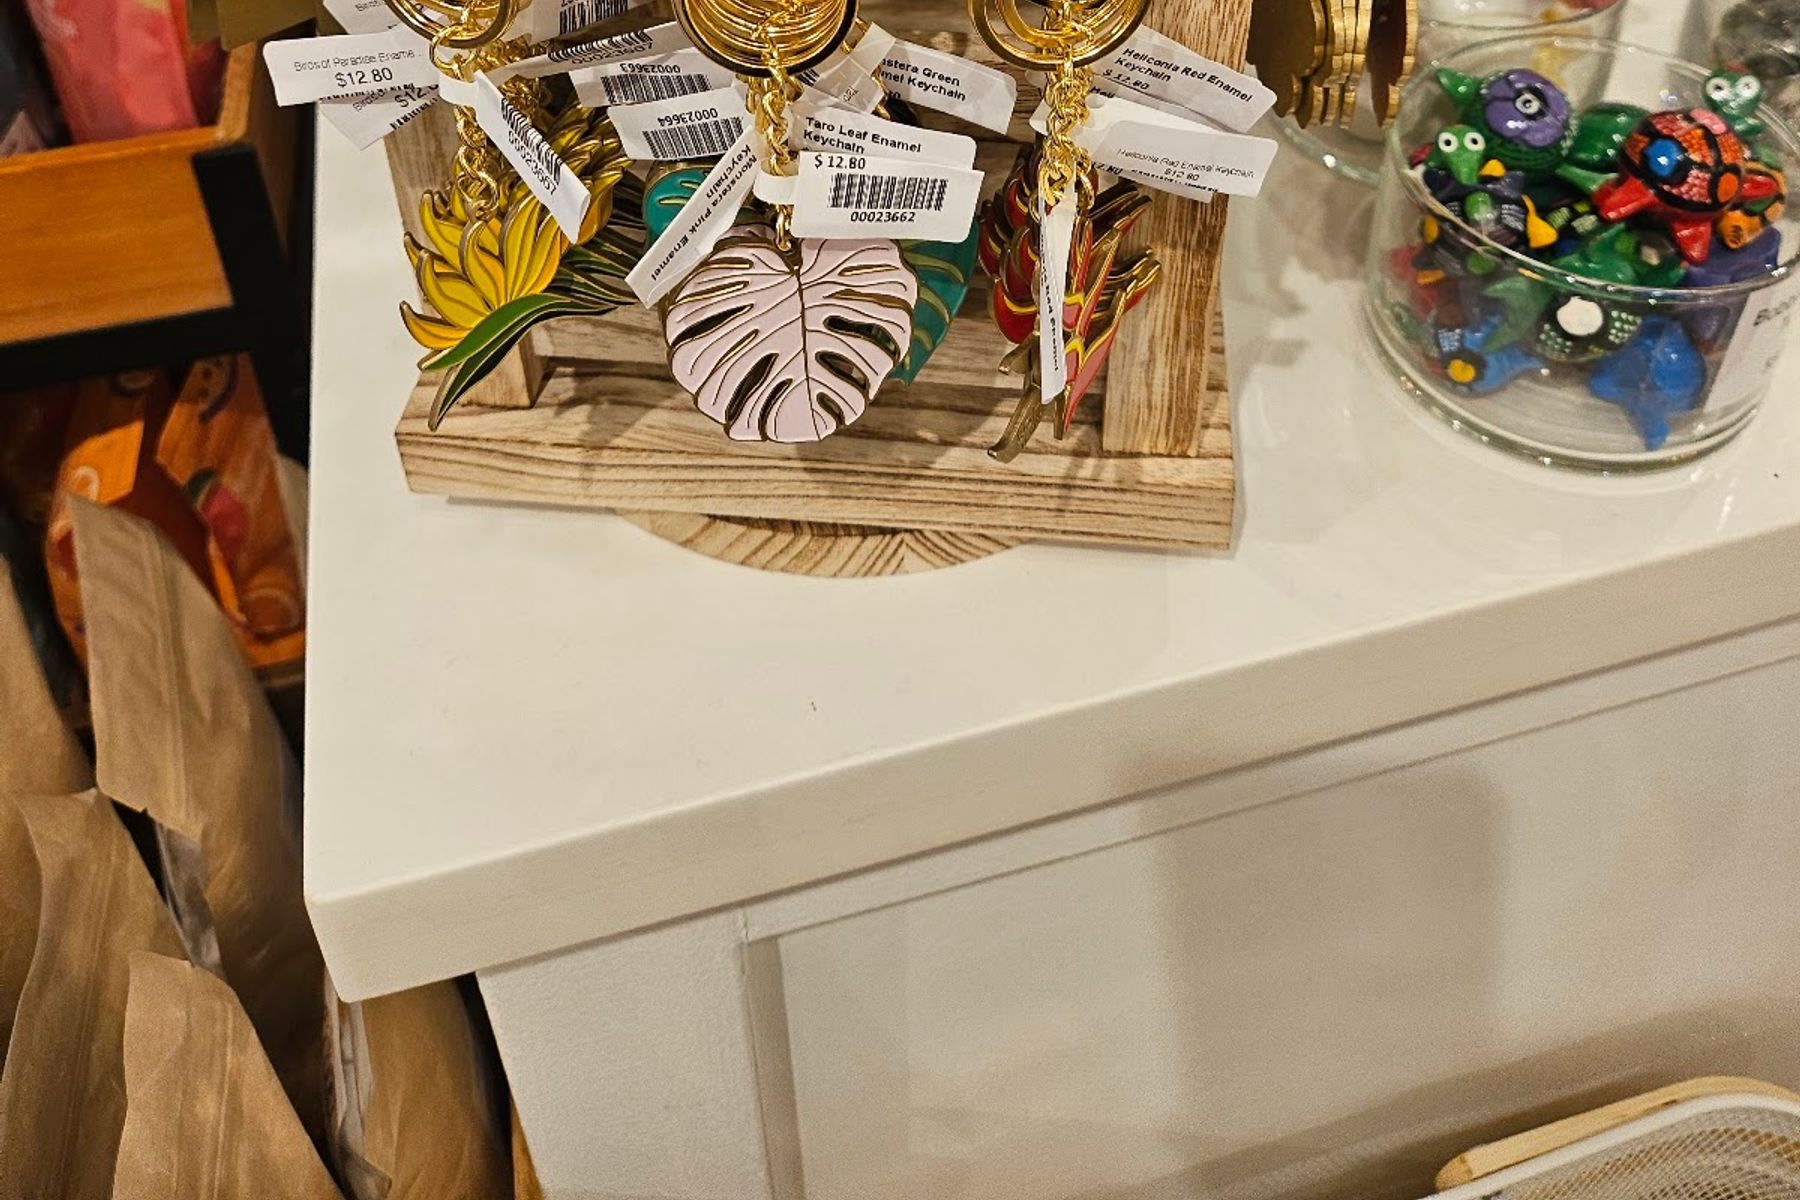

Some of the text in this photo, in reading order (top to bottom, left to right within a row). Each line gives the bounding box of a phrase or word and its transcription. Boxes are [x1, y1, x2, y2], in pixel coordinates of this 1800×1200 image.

[335, 67, 393, 88] $12.80
[923, 67, 960, 87] Green
[1115, 57, 1172, 83] Keychain
[1122, 47, 1254, 103] Heliconia Red Enamel
[907, 74, 966, 102] Keychain
[657, 107, 719, 127] 00023664
[803, 130, 865, 155] Keychain
[806, 116, 922, 154] Taro Leaf Enamel
[706, 144, 752, 200] Keychain
[814, 156, 867, 171] $ 12.80
[651, 154, 758, 281] Monstera Pink Enamel
[850, 211, 916, 224] 00023662
